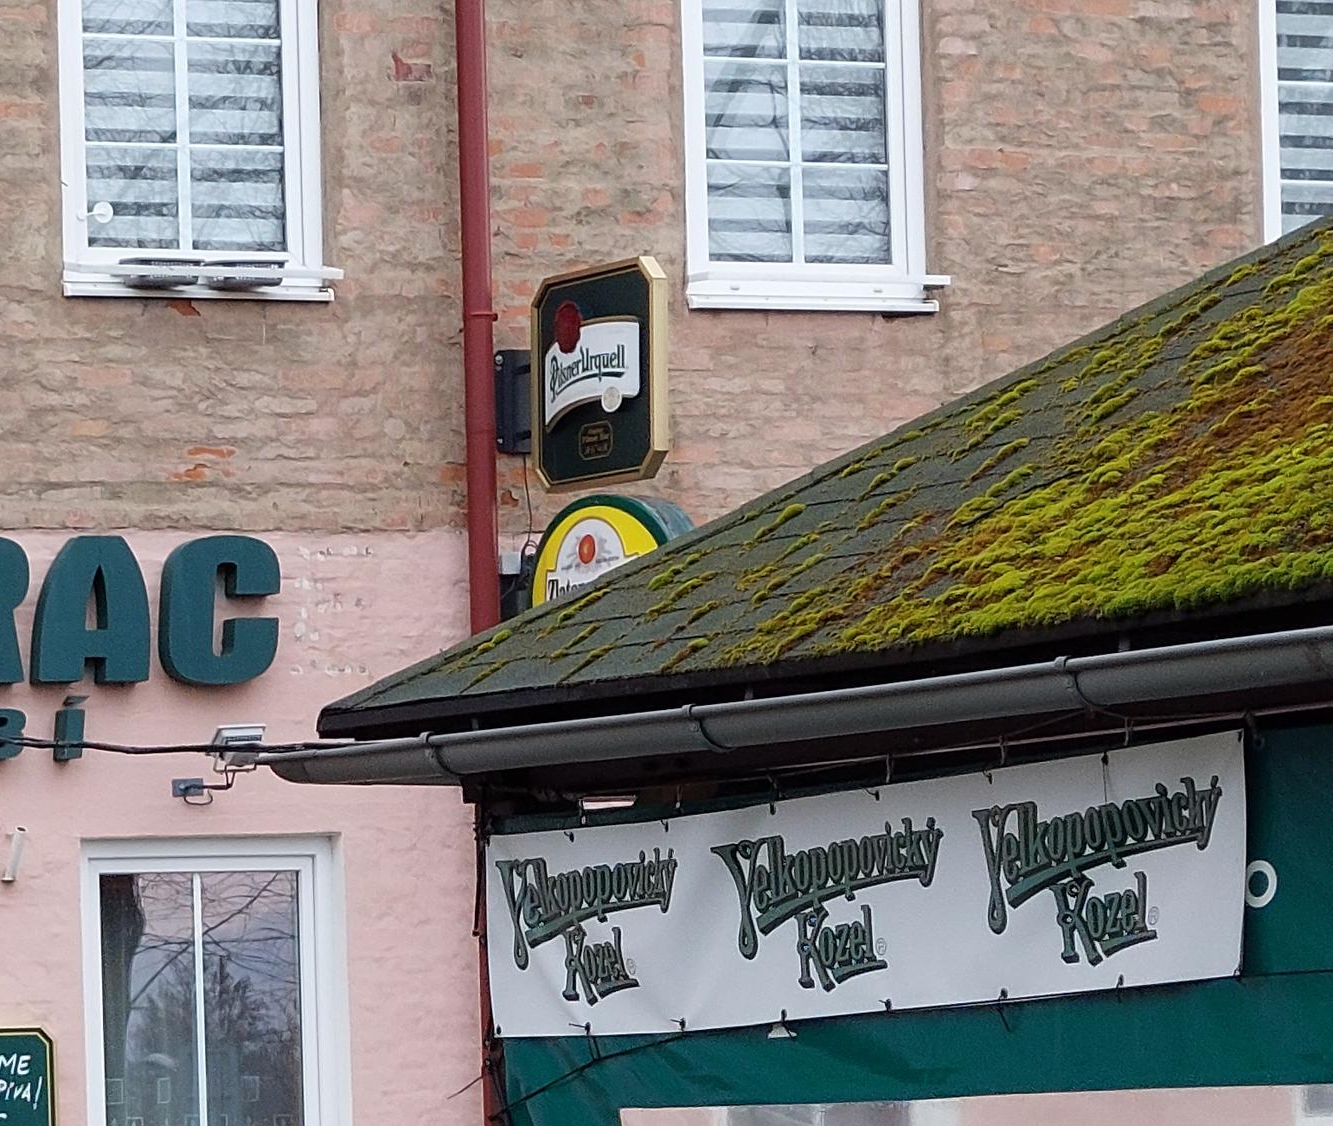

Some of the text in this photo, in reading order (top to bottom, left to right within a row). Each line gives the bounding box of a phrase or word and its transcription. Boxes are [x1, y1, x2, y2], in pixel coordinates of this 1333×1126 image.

[550, 343, 625, 404] Pilsner Urquell
[794, 903, 888, 993] Kozel
[1050, 871, 1158, 967] Kozel
[562, 922, 640, 1006] Kozel
